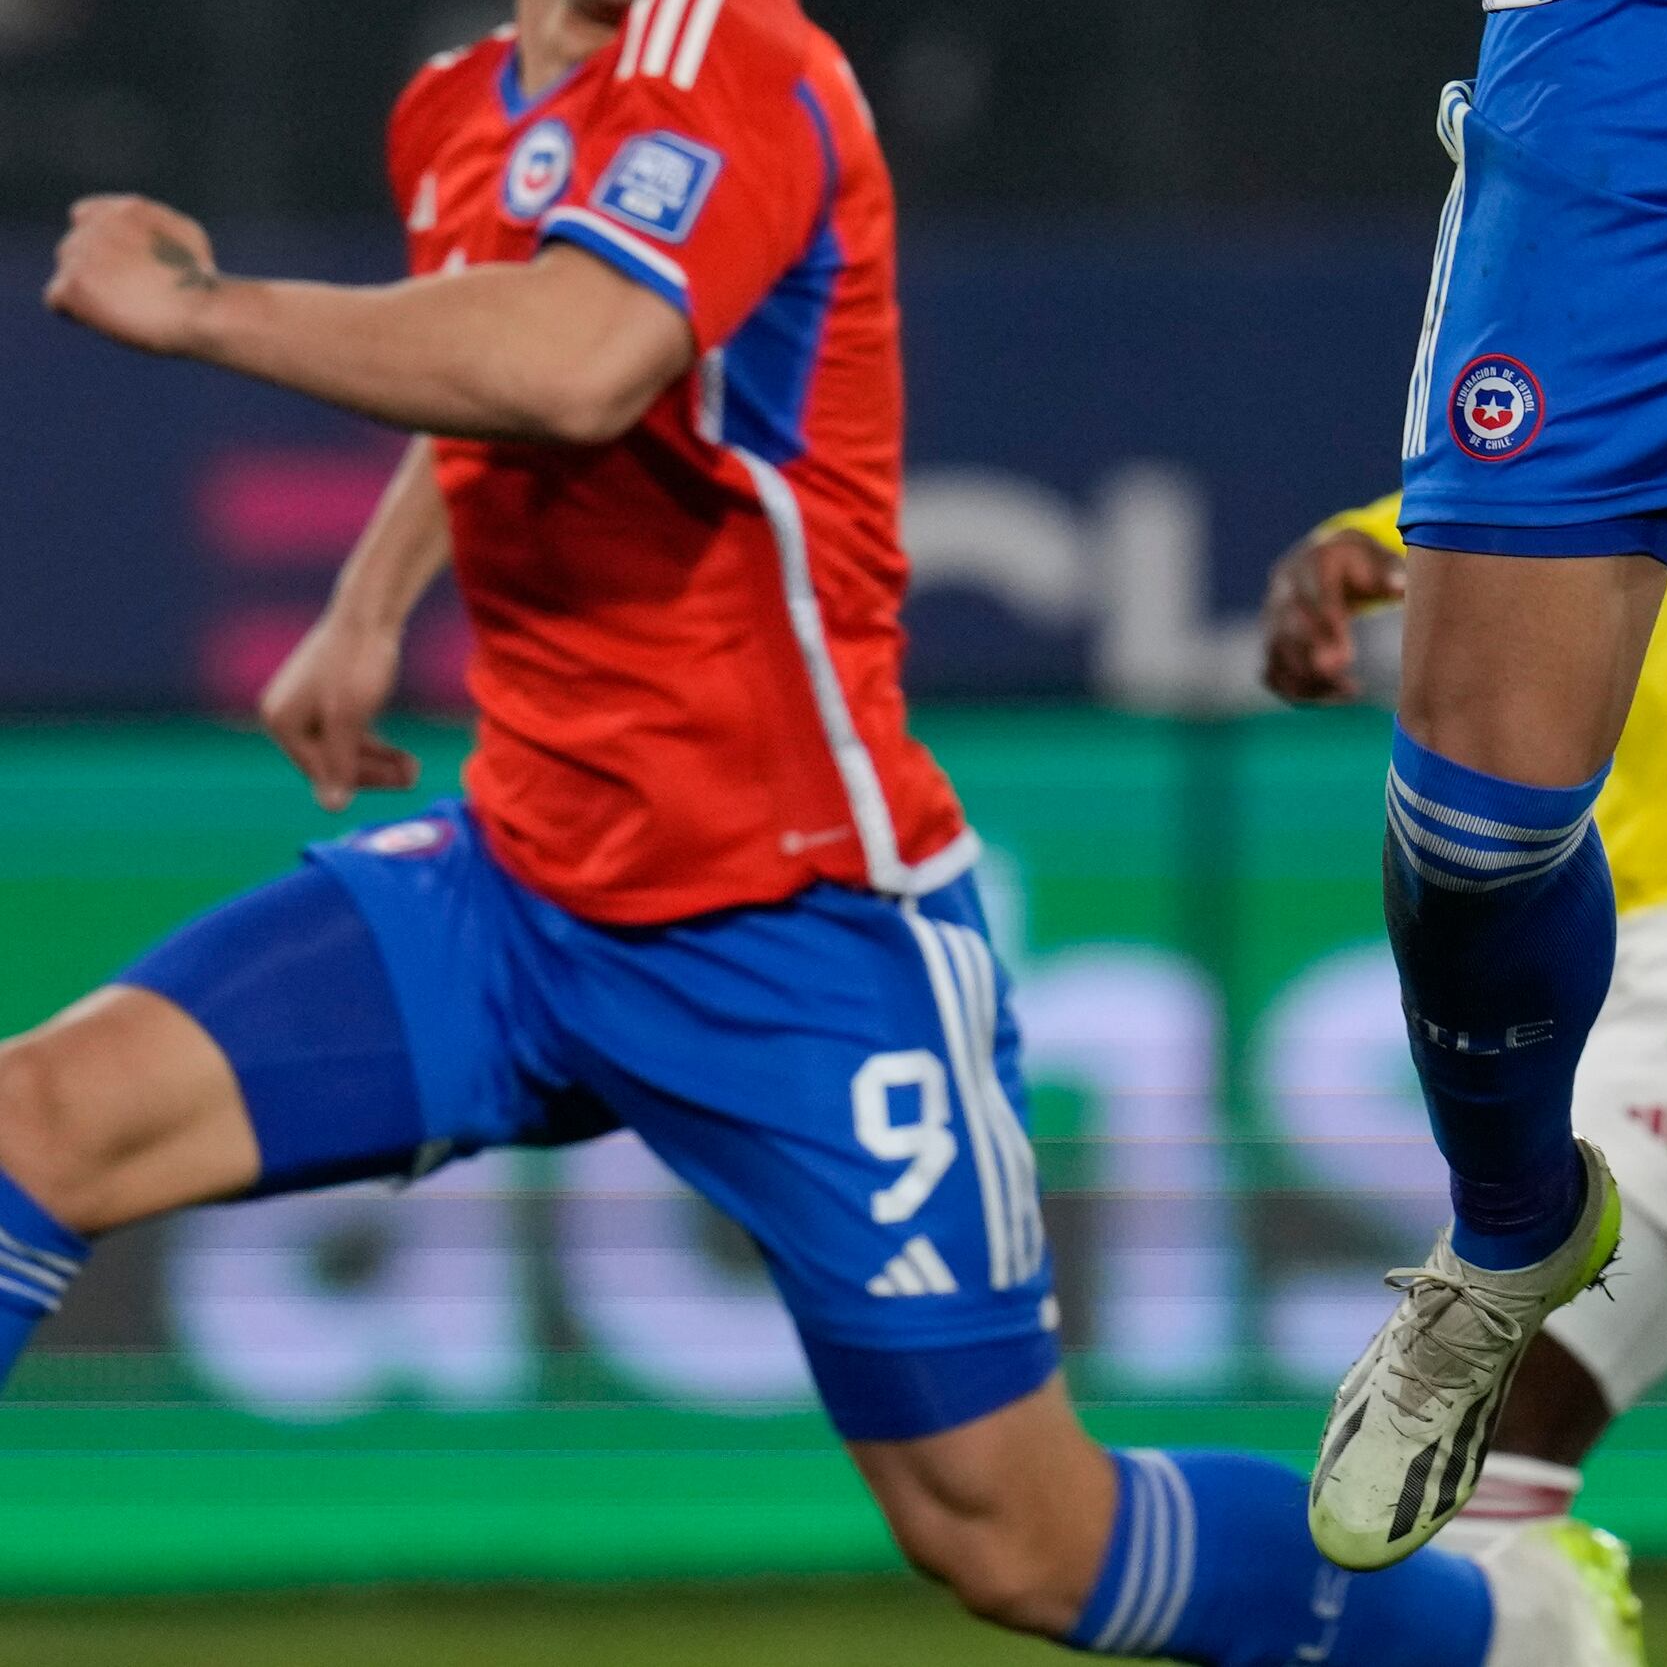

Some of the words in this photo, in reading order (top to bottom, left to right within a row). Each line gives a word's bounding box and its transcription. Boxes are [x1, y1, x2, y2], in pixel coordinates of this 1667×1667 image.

[1456, 366, 1497, 408] FEDERACION
[1502, 368, 1516, 381] DE
[1514, 376, 1537, 413] FUTBOL
[1468, 435, 1482, 448] DE
[1485, 437, 1513, 451] CHILE
[850, 1047, 959, 1225] 9
